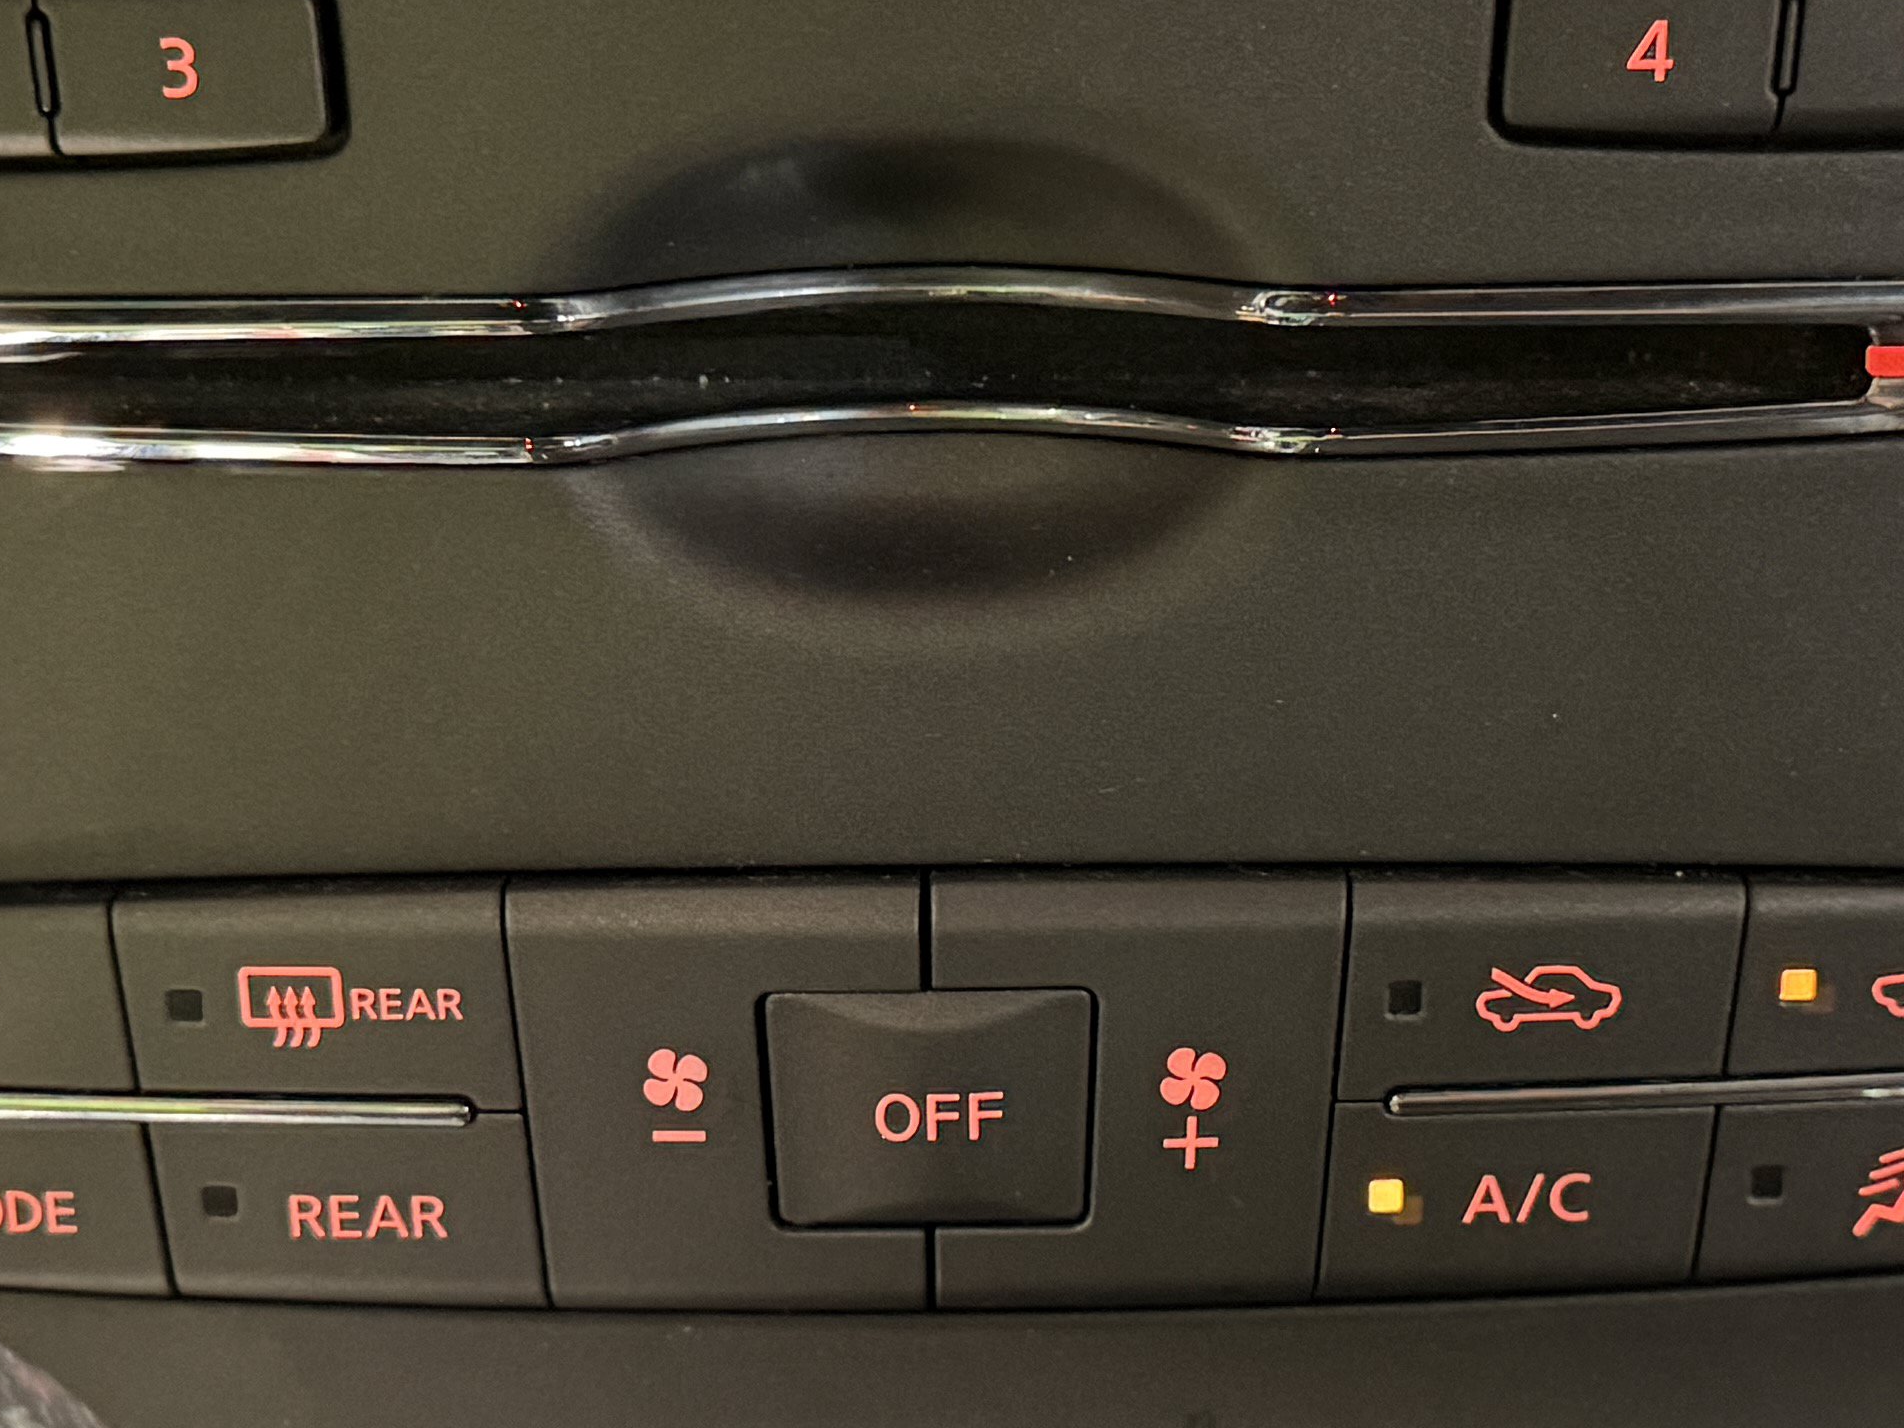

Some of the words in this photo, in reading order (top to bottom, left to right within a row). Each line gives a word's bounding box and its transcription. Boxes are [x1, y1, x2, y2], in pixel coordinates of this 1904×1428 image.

[158, 35, 200, 101] 3
[1625, 18, 1676, 84] 4
[347, 985, 465, 1023] REAR
[874, 1090, 1005, 1144] OFF
[286, 1193, 450, 1242] REAR
[1462, 1172, 1593, 1226] A/C
